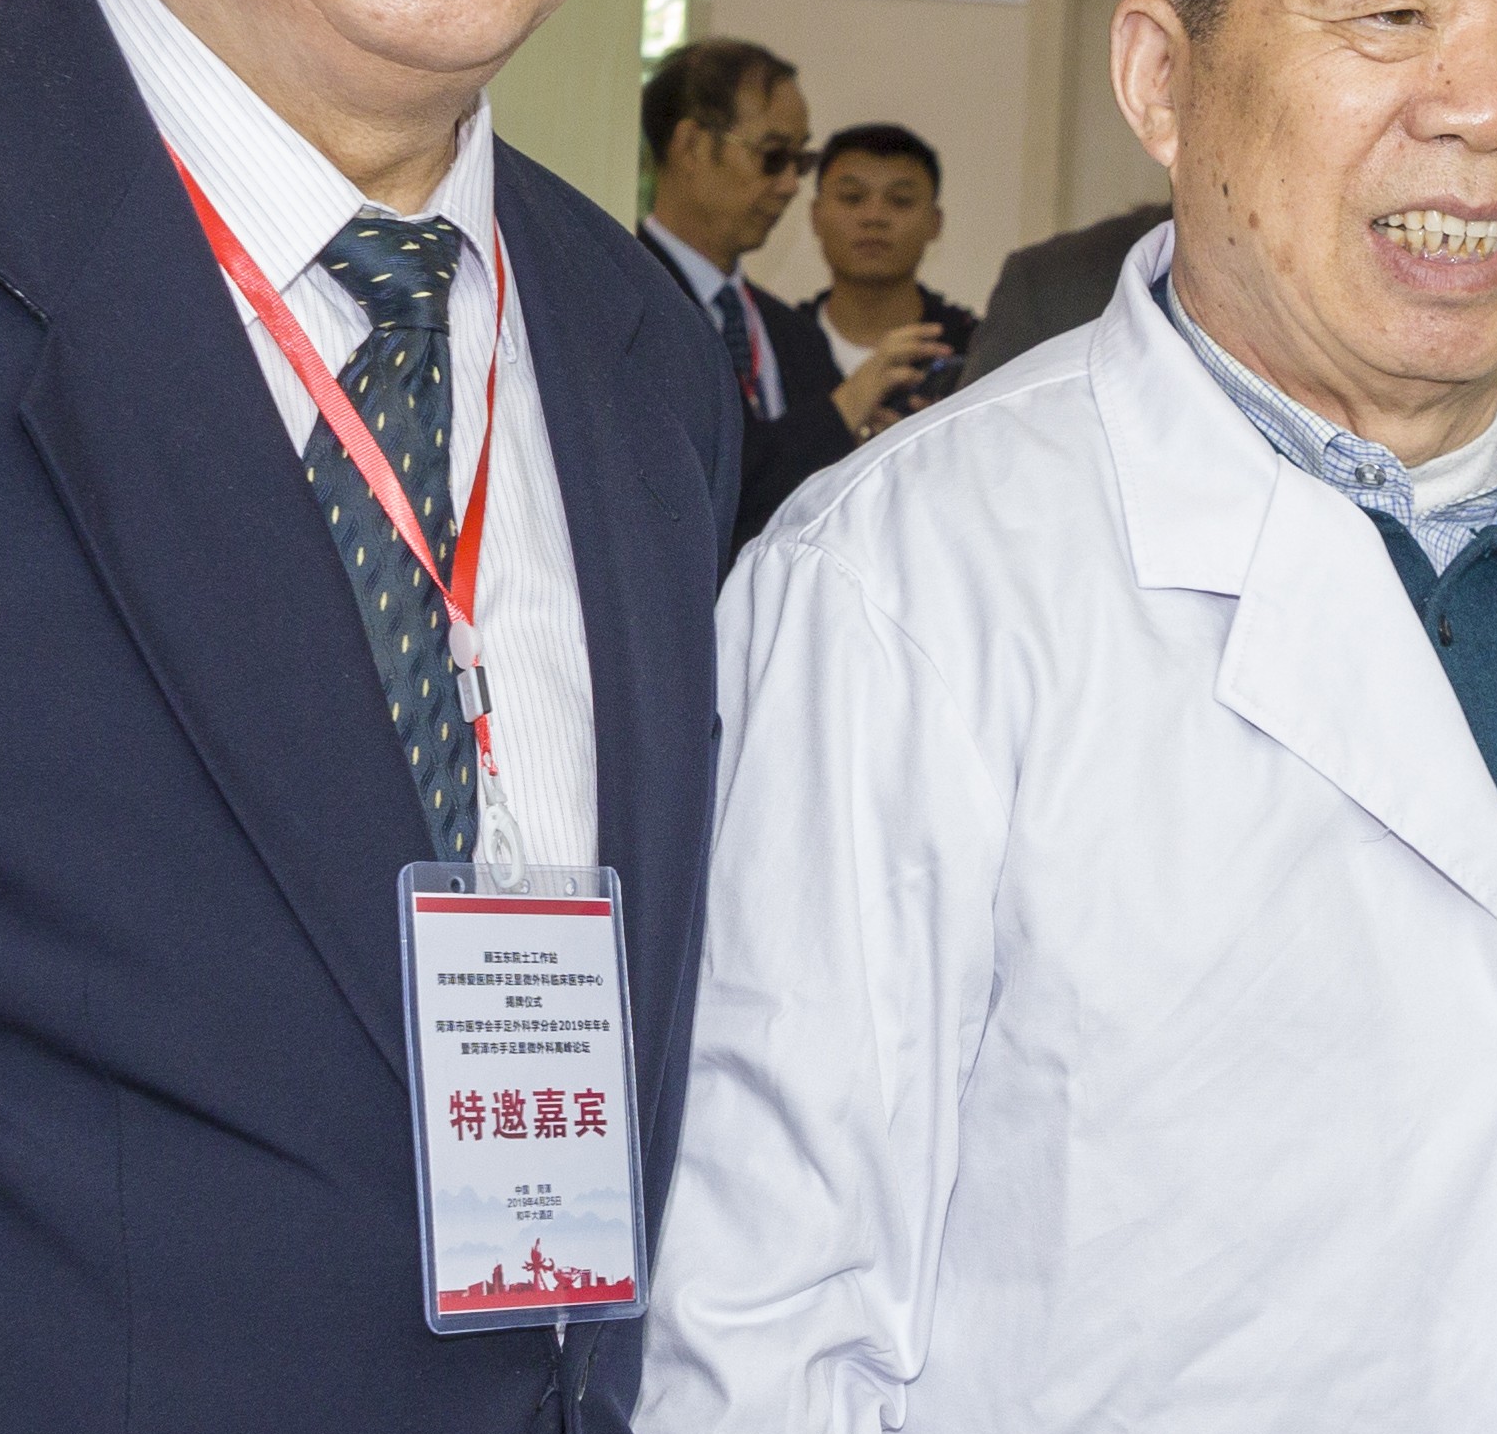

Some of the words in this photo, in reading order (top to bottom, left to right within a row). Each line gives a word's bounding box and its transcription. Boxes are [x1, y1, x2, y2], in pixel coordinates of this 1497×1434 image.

[505, 996, 543, 1009] 揭牌仪式
[449, 1087, 608, 1141] 特邀嘉宾
[507, 1196, 562, 1208] 2019年4月25日
